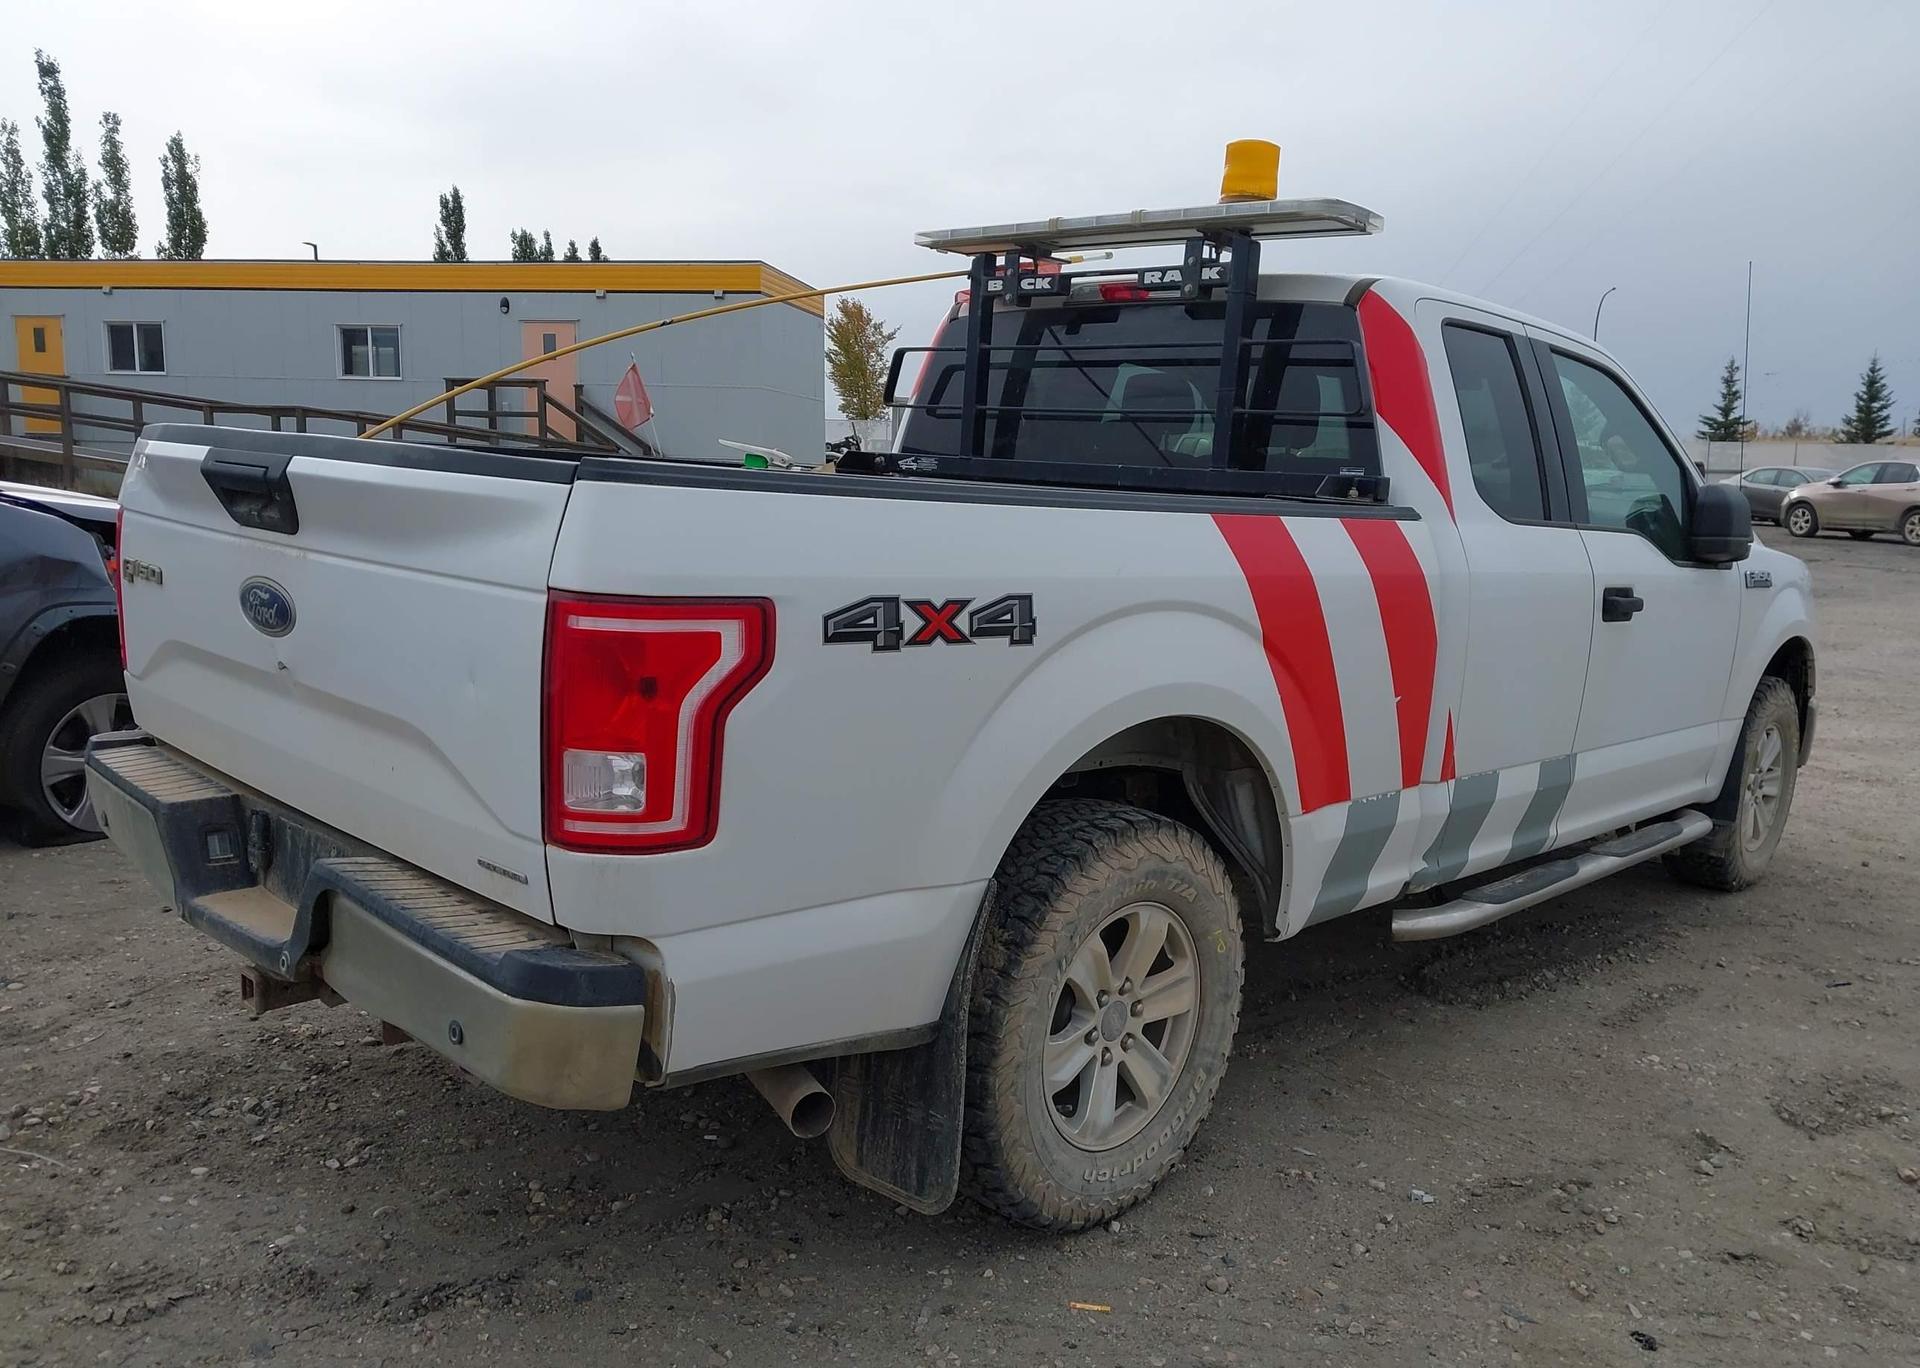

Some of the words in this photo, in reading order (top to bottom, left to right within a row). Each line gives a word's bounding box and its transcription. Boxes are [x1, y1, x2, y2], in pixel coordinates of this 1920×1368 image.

[987, 277, 1053, 292] BCK
[1143, 266, 1223, 284] RAK
[247, 587, 280, 626] Ford
